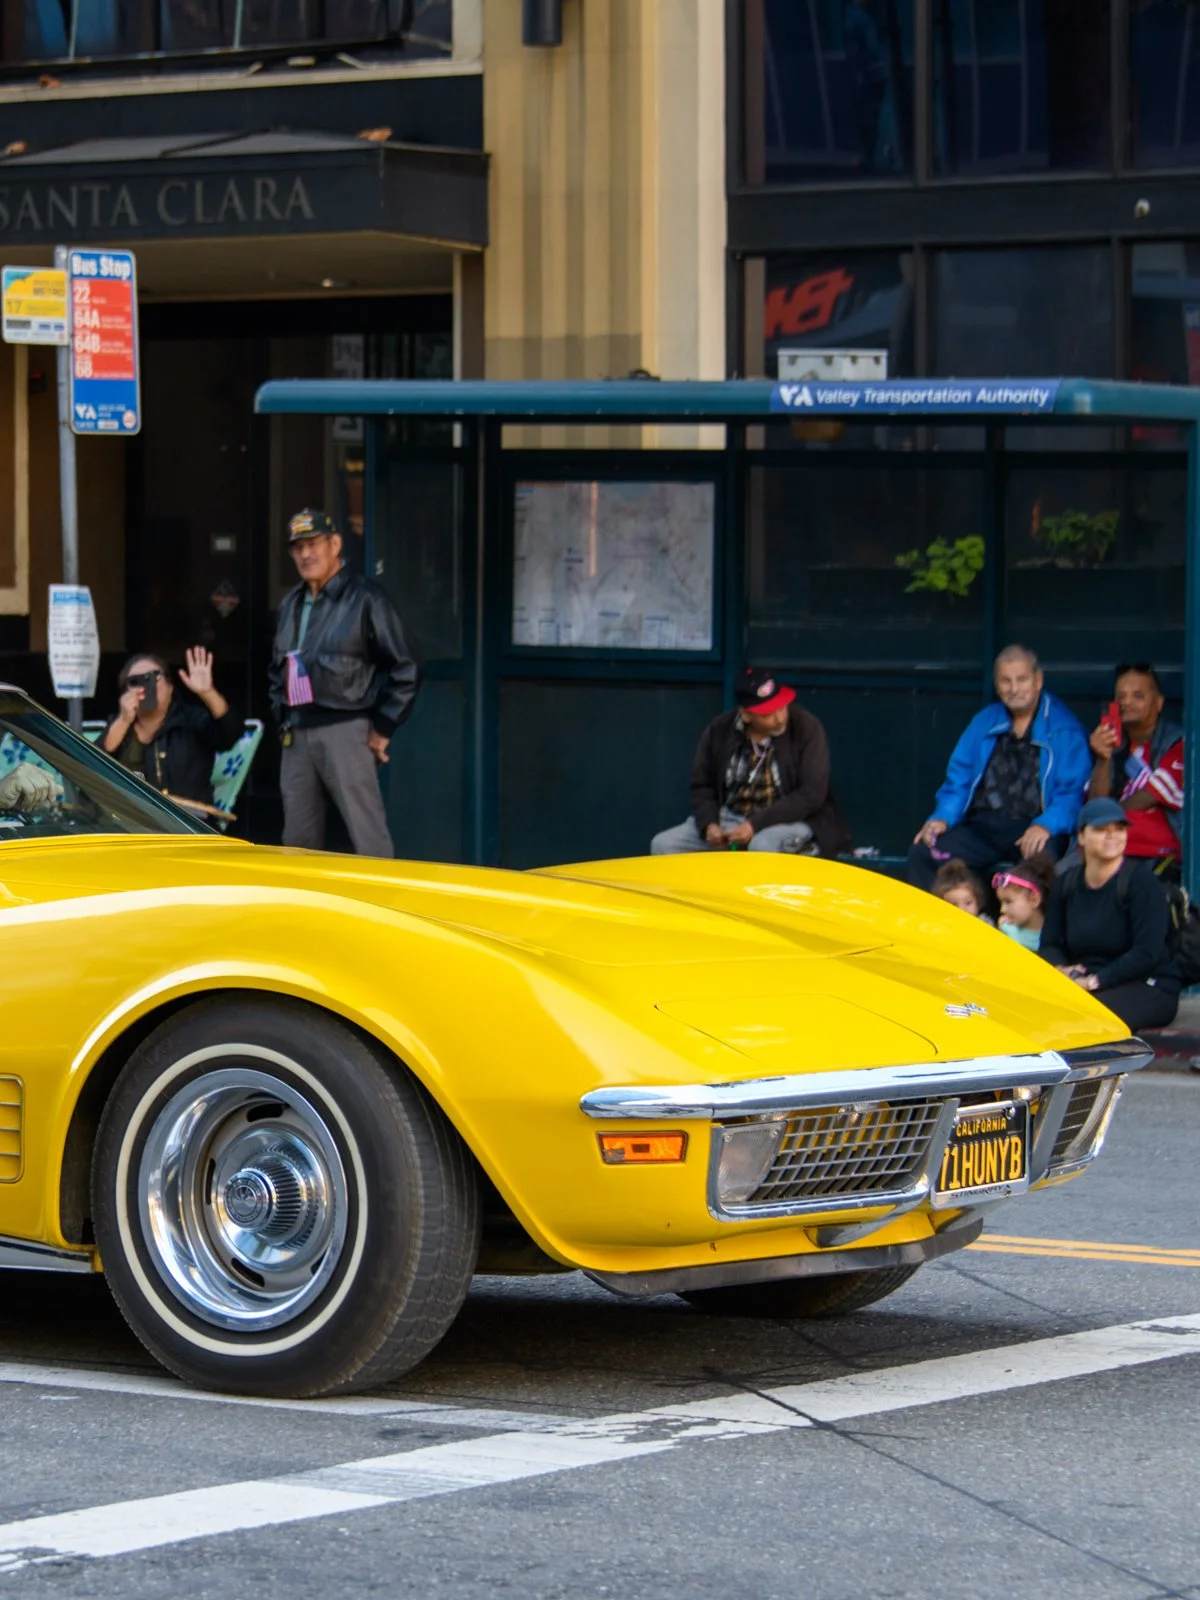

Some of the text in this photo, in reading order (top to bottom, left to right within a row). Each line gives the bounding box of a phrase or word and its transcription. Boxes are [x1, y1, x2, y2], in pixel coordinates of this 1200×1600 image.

[157, 174, 315, 226] CLARA
[72, 254, 131, 280] Bus Stop
[816, 387, 860, 408] Valley
[864, 387, 970, 406] Transportation
[975, 386, 1049, 407] Authority
[956, 1116, 1007, 1137] CALIFORNIA
